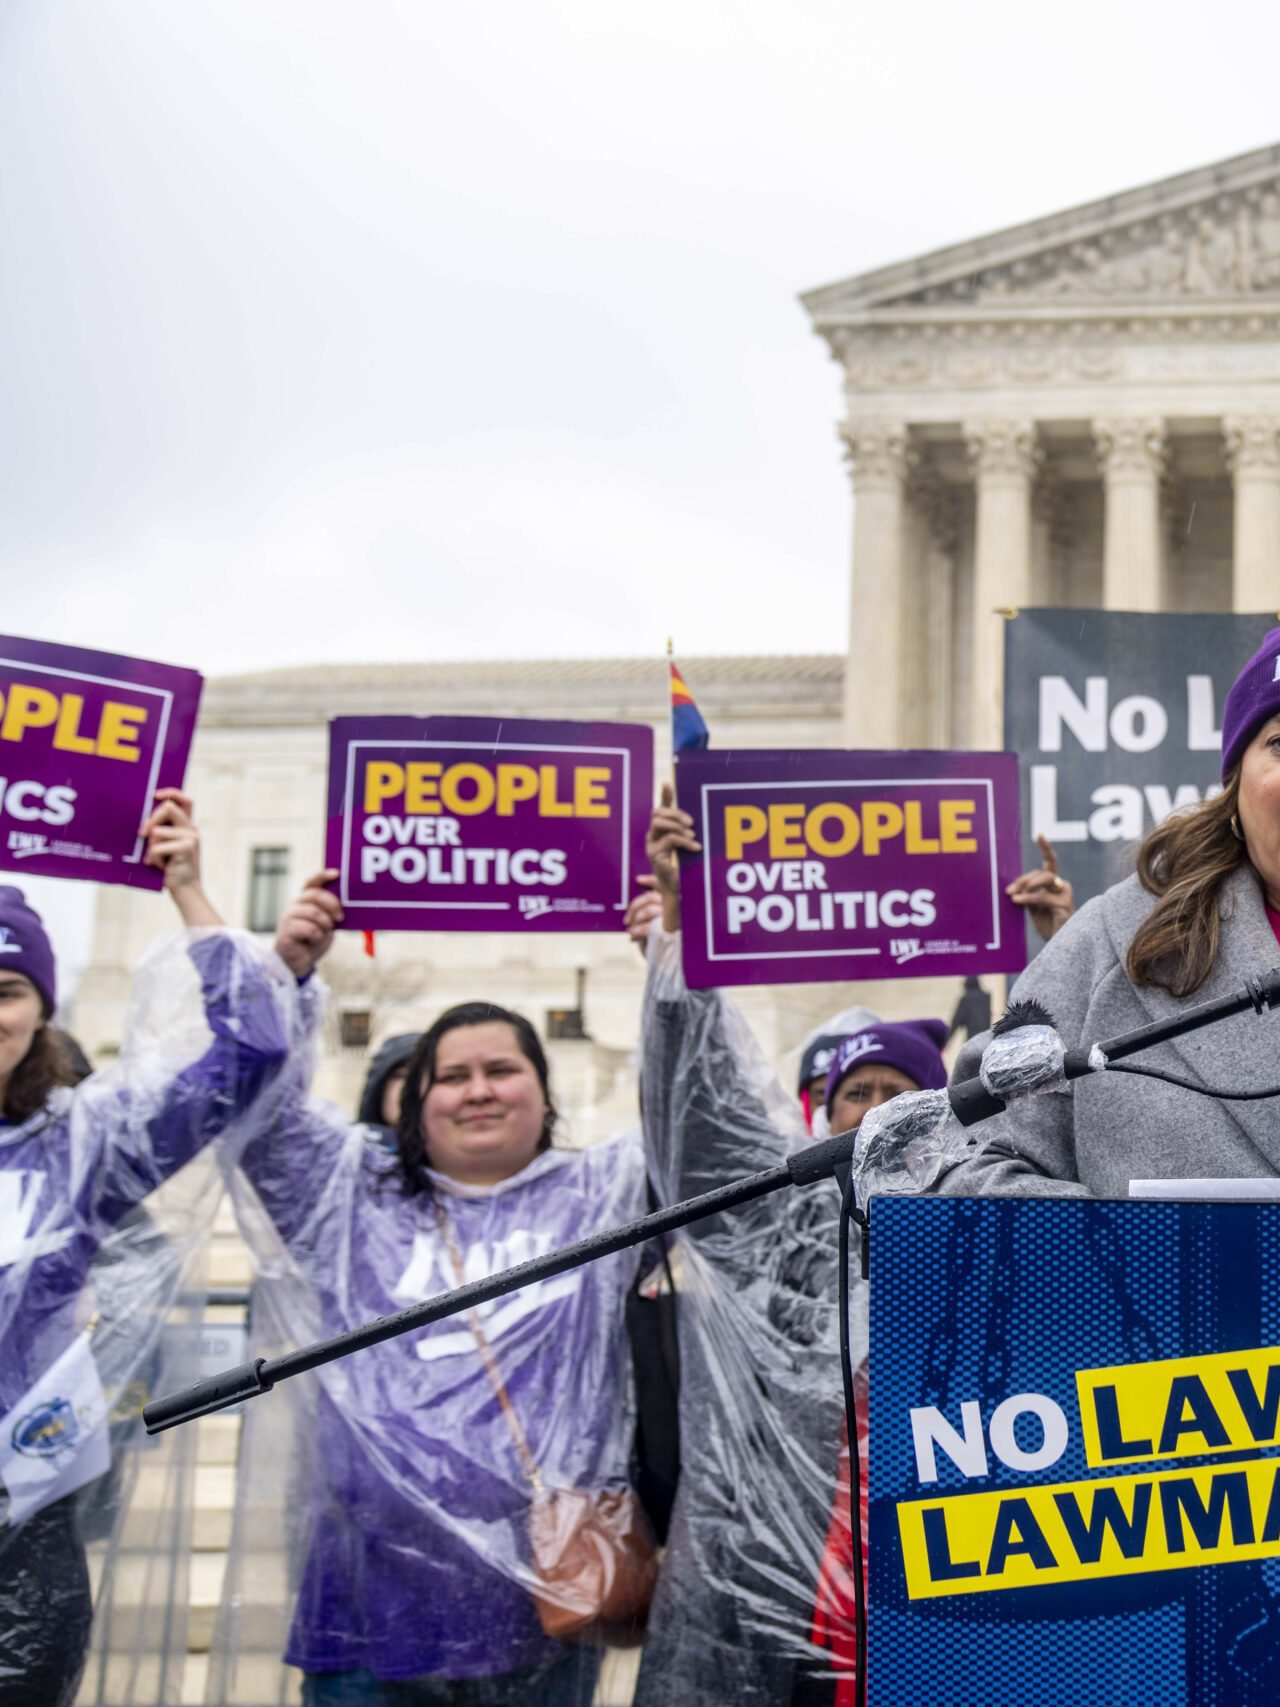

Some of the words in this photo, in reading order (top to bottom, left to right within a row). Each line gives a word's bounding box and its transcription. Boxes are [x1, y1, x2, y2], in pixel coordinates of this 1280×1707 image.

[0, 683, 148, 763] PLE
[1038, 676, 1168, 752] No
[364, 760, 611, 818] PEOPLE
[363, 815, 461, 847] OVER
[724, 799, 978, 860] PEOPLE
[361, 846, 567, 886] POLITICS
[725, 860, 828, 893] OVER
[727, 888, 937, 934] POLITICS
[909, 1392, 1070, 1484] NO
